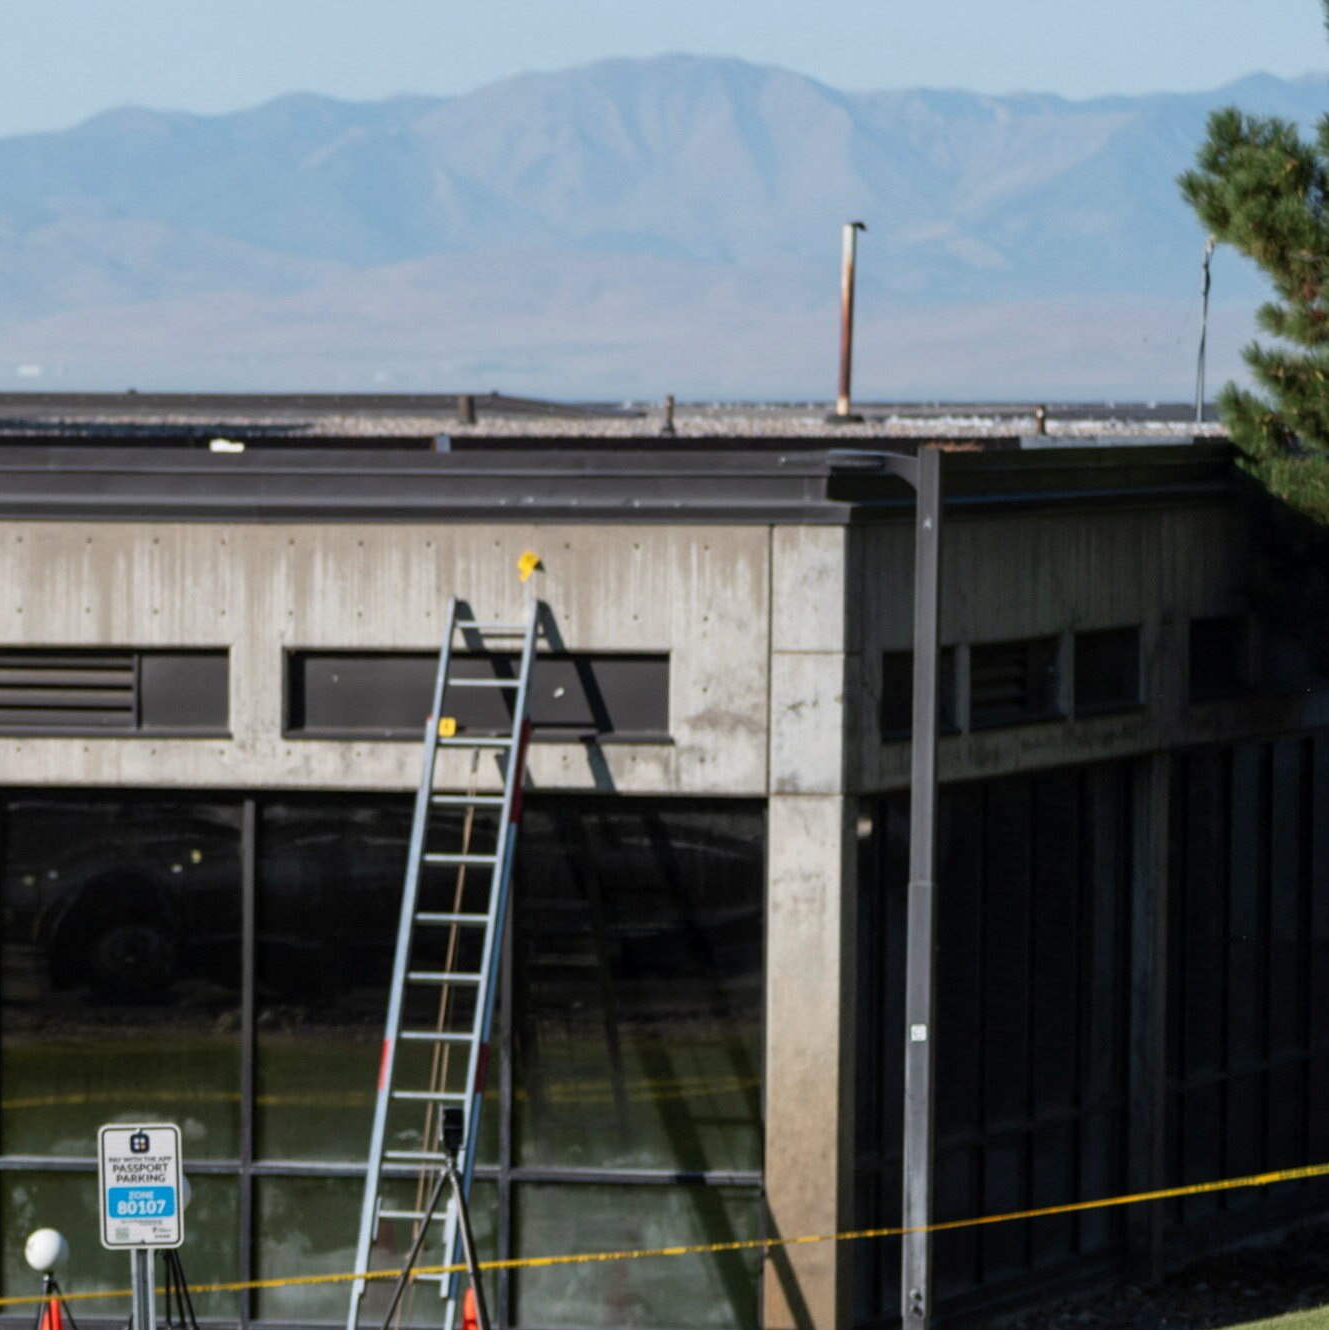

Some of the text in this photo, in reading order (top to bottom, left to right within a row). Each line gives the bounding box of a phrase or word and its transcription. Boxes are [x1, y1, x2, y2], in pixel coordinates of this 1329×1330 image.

[112, 1163, 169, 1174] PASSPORT
[116, 1174, 166, 1183] PARKING
[128, 1191, 154, 1200] ZONE
[116, 1199, 167, 1215] 80107
